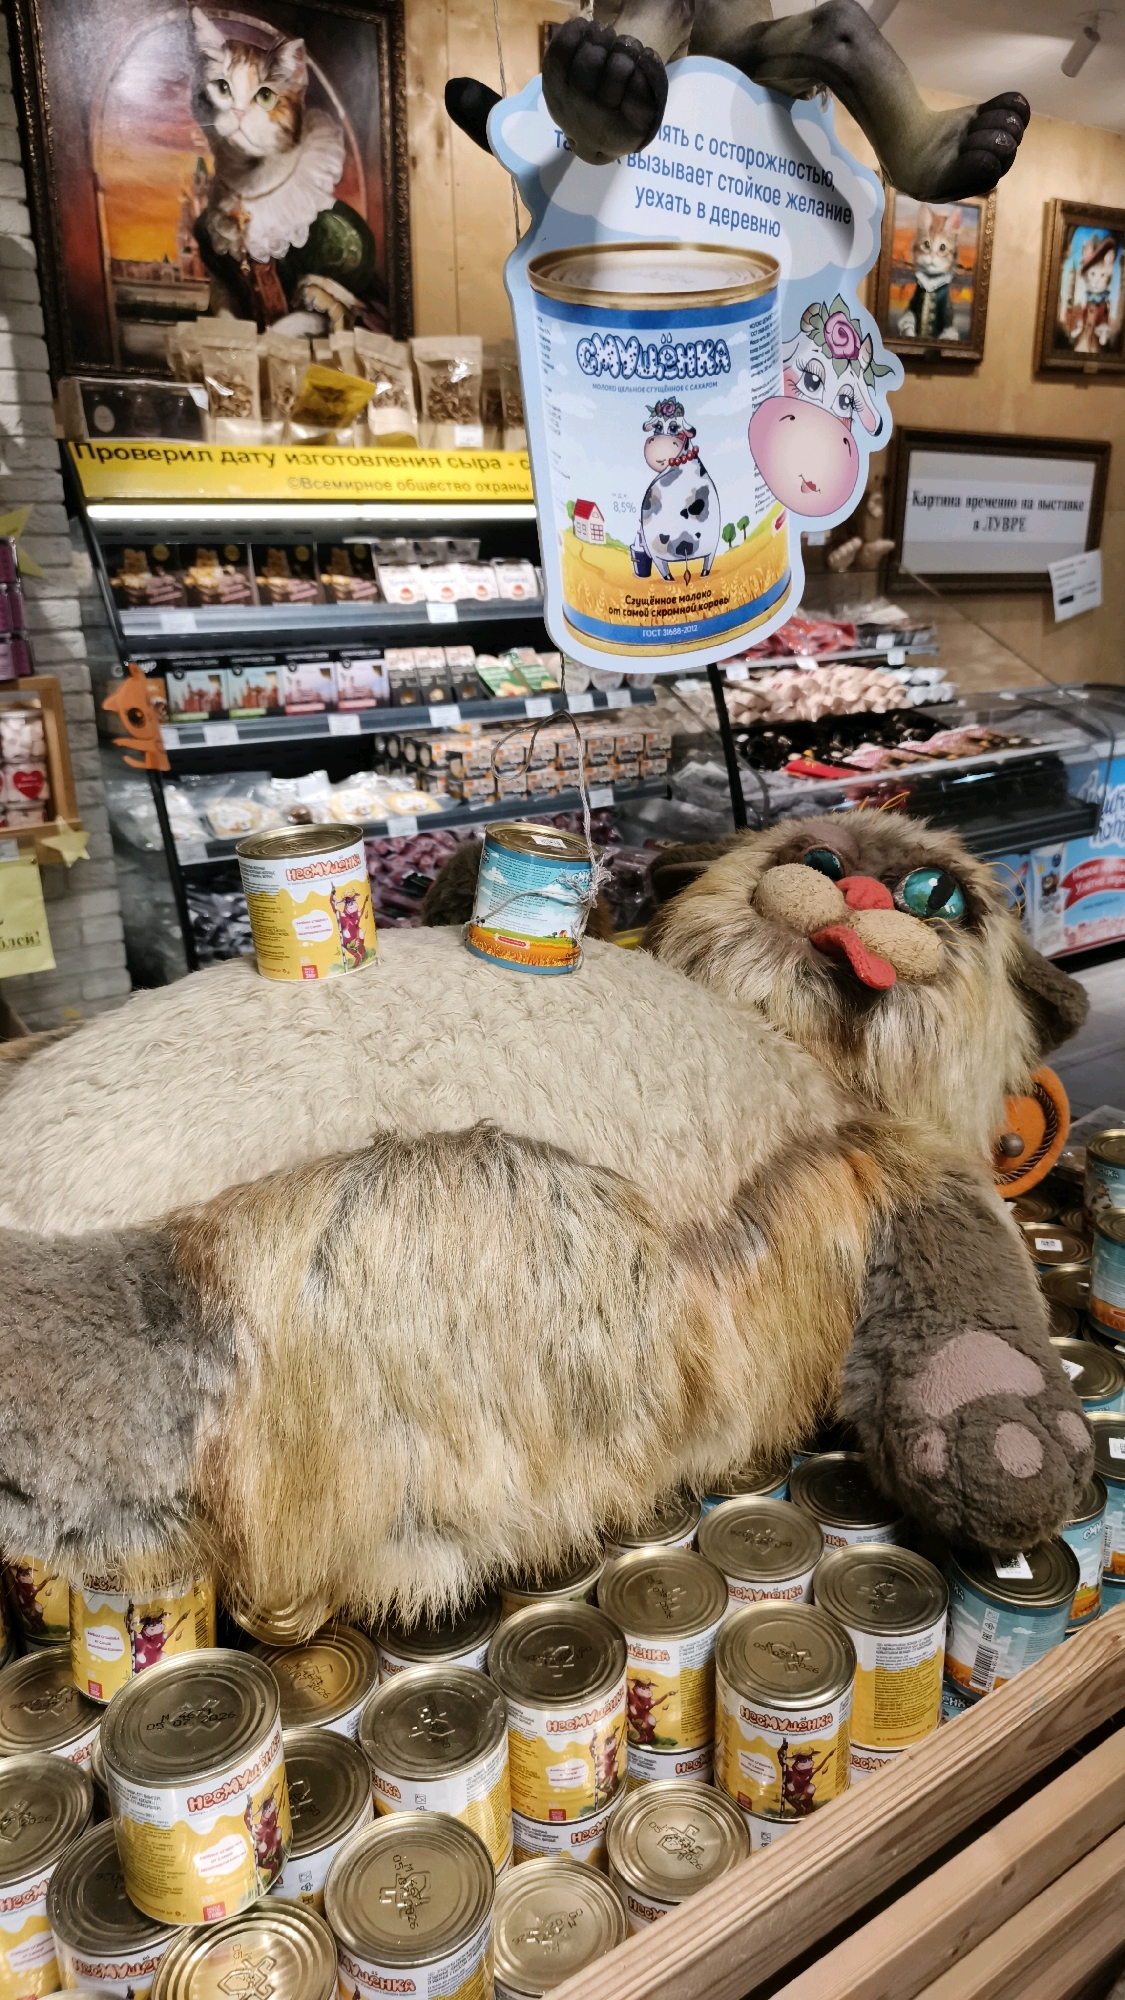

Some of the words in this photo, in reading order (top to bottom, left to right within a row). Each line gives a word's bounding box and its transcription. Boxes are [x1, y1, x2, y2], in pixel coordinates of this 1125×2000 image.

[708, 140, 836, 193] осторожностью,
[627, 151, 714, 189] вызывает
[717, 173, 782, 208] стойкое
[784, 191, 853, 225] желание
[635, 185, 692, 217] уехать
[696, 203, 706, 219] в
[709, 208, 781, 239] деревню
[74, 441, 213, 466] Проверил
[221, 449, 277, 470] дату
[286, 452, 440, 470] изготовления
[446, 455, 502, 473] сыра
[396, 477, 472, 495] общество
[613, 500, 637, 514] 8,5%
[912, 490, 961, 511] Картина
[965, 496, 1017, 512] временно
[1021, 499, 1033, 509] на
[1037, 499, 1085, 512] выставке
[972, 521, 979, 531] в
[982, 517, 1027, 533] ЛУВРЕ
[625, 594, 676, 608] Сгущённое
[679, 589, 712, 604] молоко
[608, 607, 620, 616] от
[622, 606, 649, 618] самой
[651, 602, 696, 619] скромной
[643, 627, 661, 638] ГОСТ
